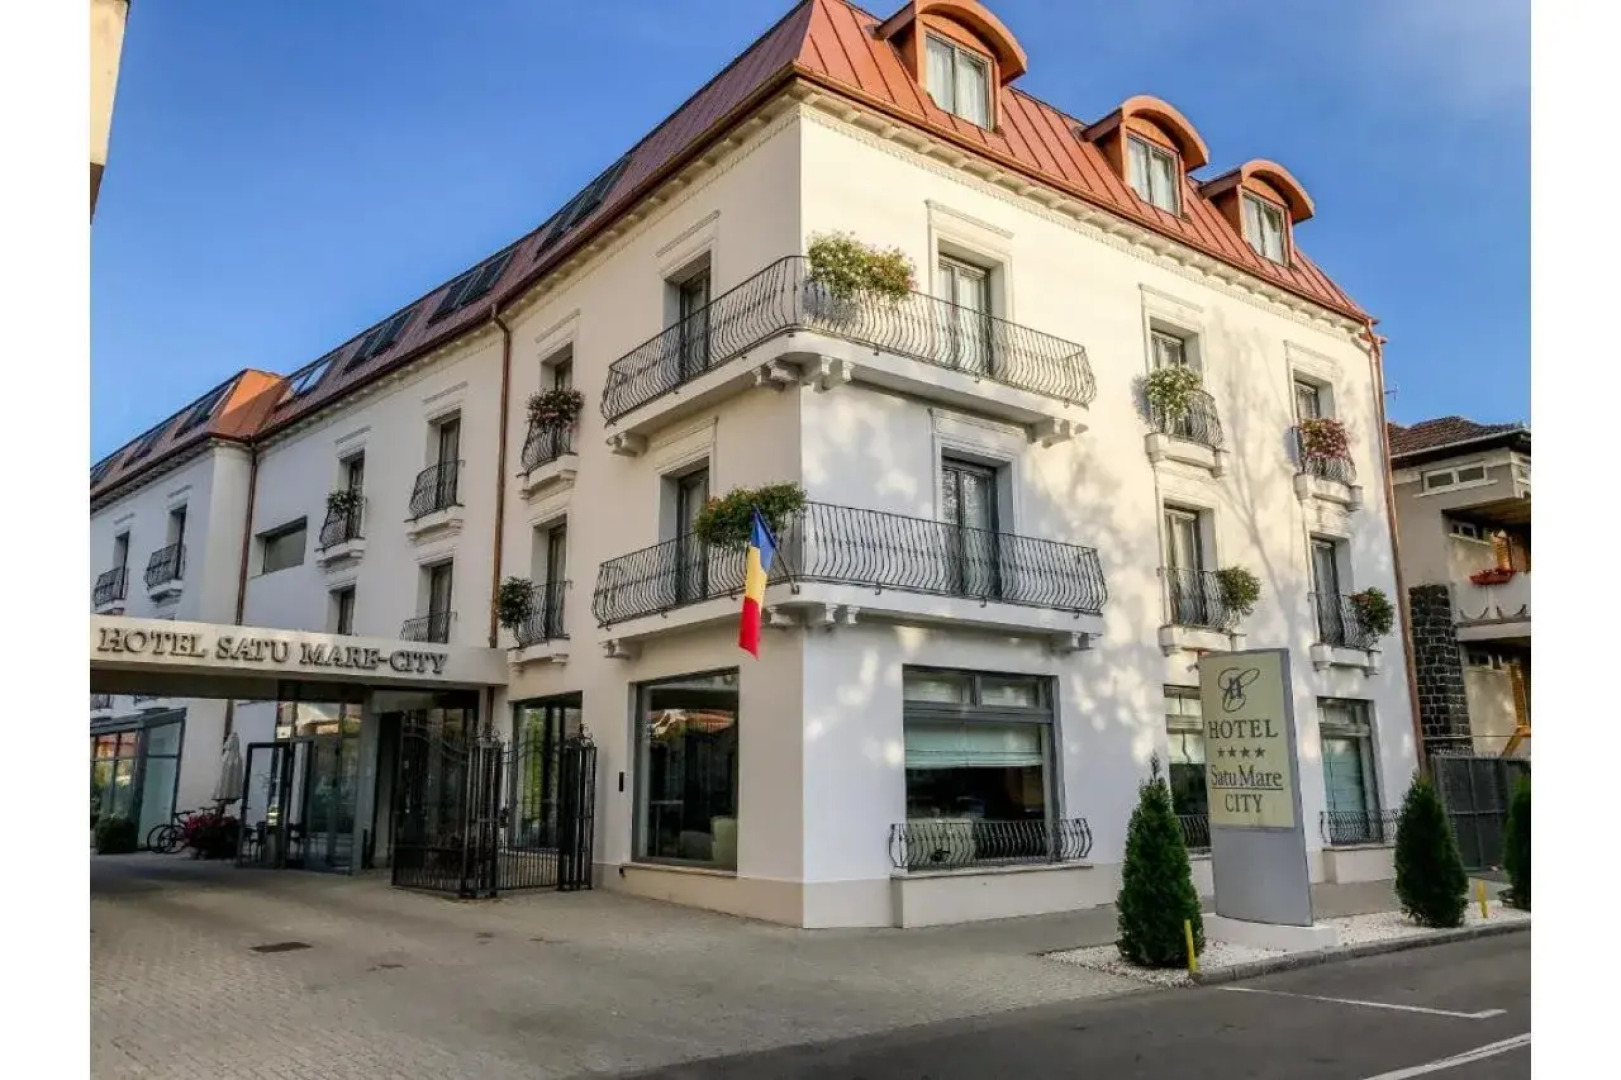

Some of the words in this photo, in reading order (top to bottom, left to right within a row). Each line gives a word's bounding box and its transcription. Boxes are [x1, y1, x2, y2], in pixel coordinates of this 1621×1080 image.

[97, 628, 206, 658] HOTEL
[216, 635, 291, 662] SATU
[299, 642, 449, 674] MARE-CITY
[1208, 719, 1279, 739] HOTEL
[1225, 794, 1263, 813] CITY
